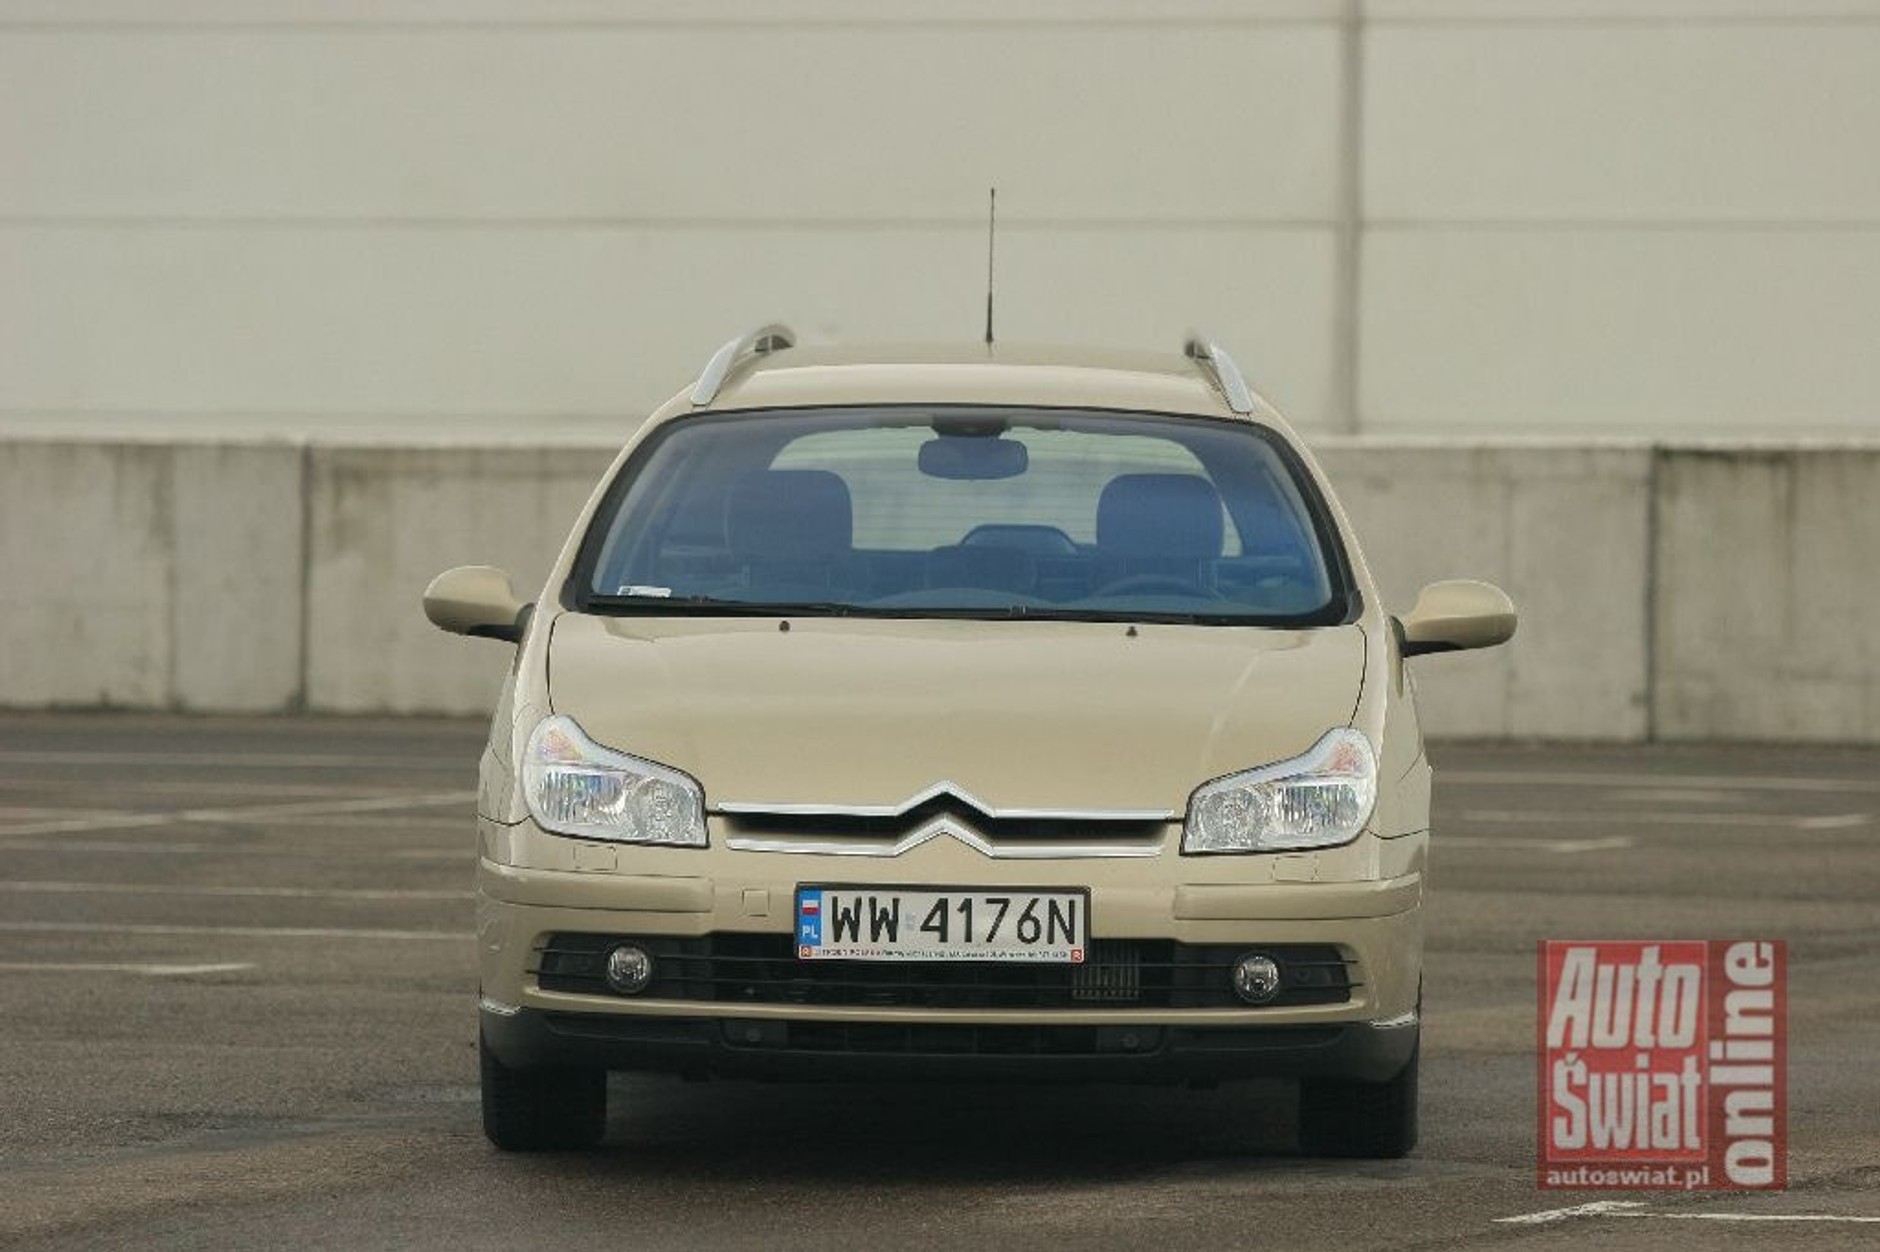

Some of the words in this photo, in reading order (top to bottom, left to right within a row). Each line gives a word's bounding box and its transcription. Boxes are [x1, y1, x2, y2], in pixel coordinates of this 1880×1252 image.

[802, 925, 818, 938] PL
[831, 896, 899, 943] WW
[920, 898, 1075, 945] 4176N
